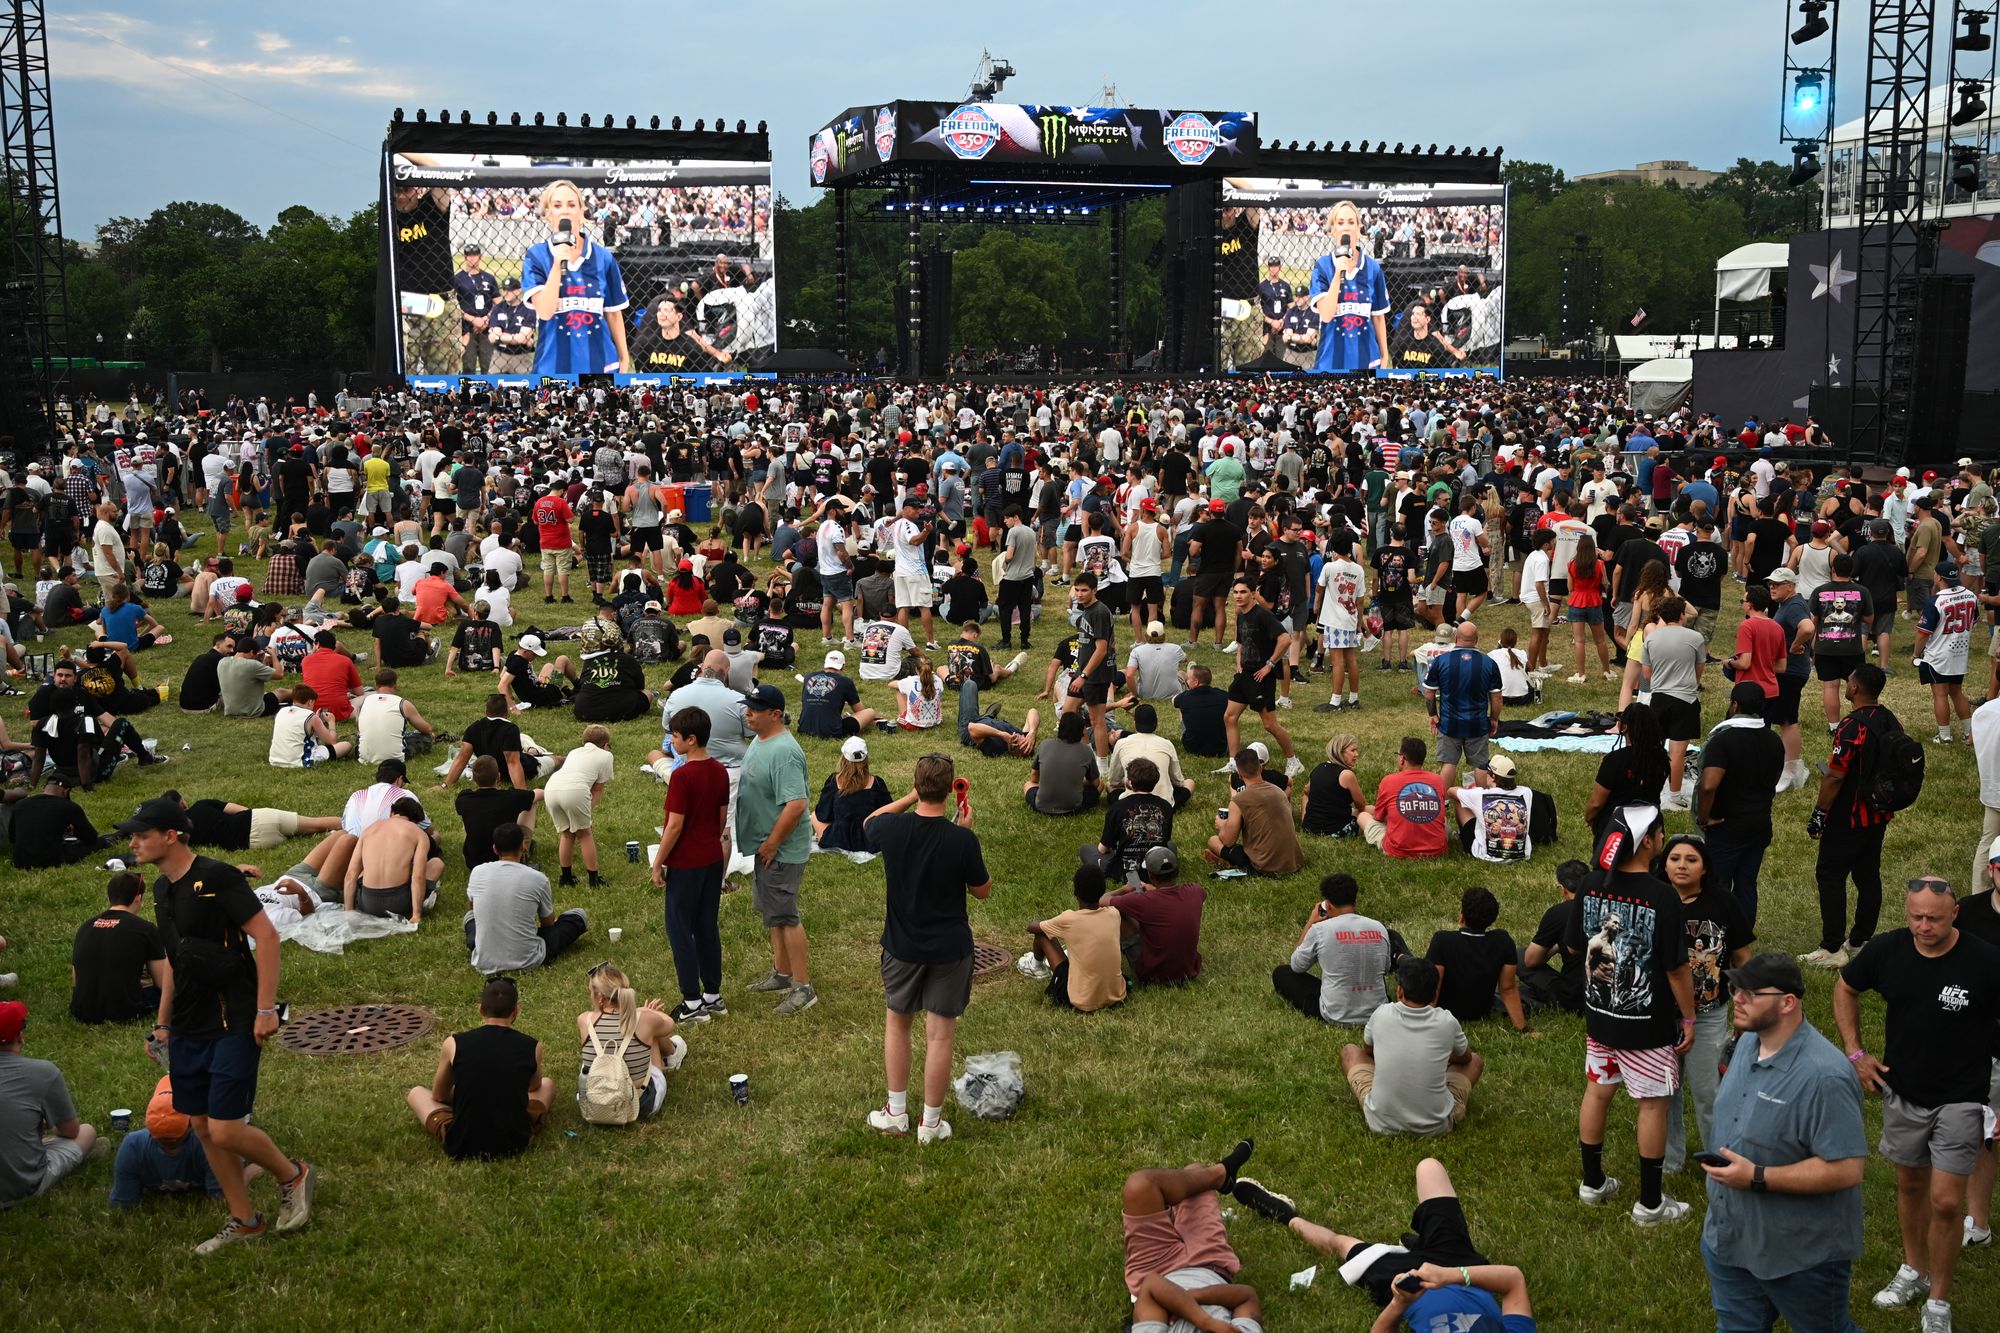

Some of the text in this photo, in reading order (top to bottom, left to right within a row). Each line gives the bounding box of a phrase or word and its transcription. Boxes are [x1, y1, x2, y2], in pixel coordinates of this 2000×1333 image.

[962, 113, 979, 121] UFC
[941, 120, 999, 135] FREEDOM
[1069, 124, 1127, 137] MONSTER
[959, 133, 984, 151] 250
[1165, 128, 1218, 142] FREEDOM
[1181, 141, 1204, 154] 250
[396, 163, 476, 181] Paramount+
[605, 167, 678, 185] Paramount+
[1222, 188, 1280, 202] Paramount+
[1377, 190, 1432, 205] Paramount+
[566, 312, 594, 330] 250
[1341, 316, 1363, 330] 250
[649, 351, 686, 367] ARMY
[1403, 350, 1431, 364] ARMY
[538, 509, 557, 526] 34
[1950, 594, 1975, 602] FREEDOM
[1942, 600, 1976, 634] 250
[1590, 890, 1651, 906] MICHAEL
[1336, 929, 1382, 941] WILSON
[1941, 986, 1969, 999] UFC
[1938, 994, 1970, 1006] FREEDOM
[1942, 1001, 1961, 1012] 250
